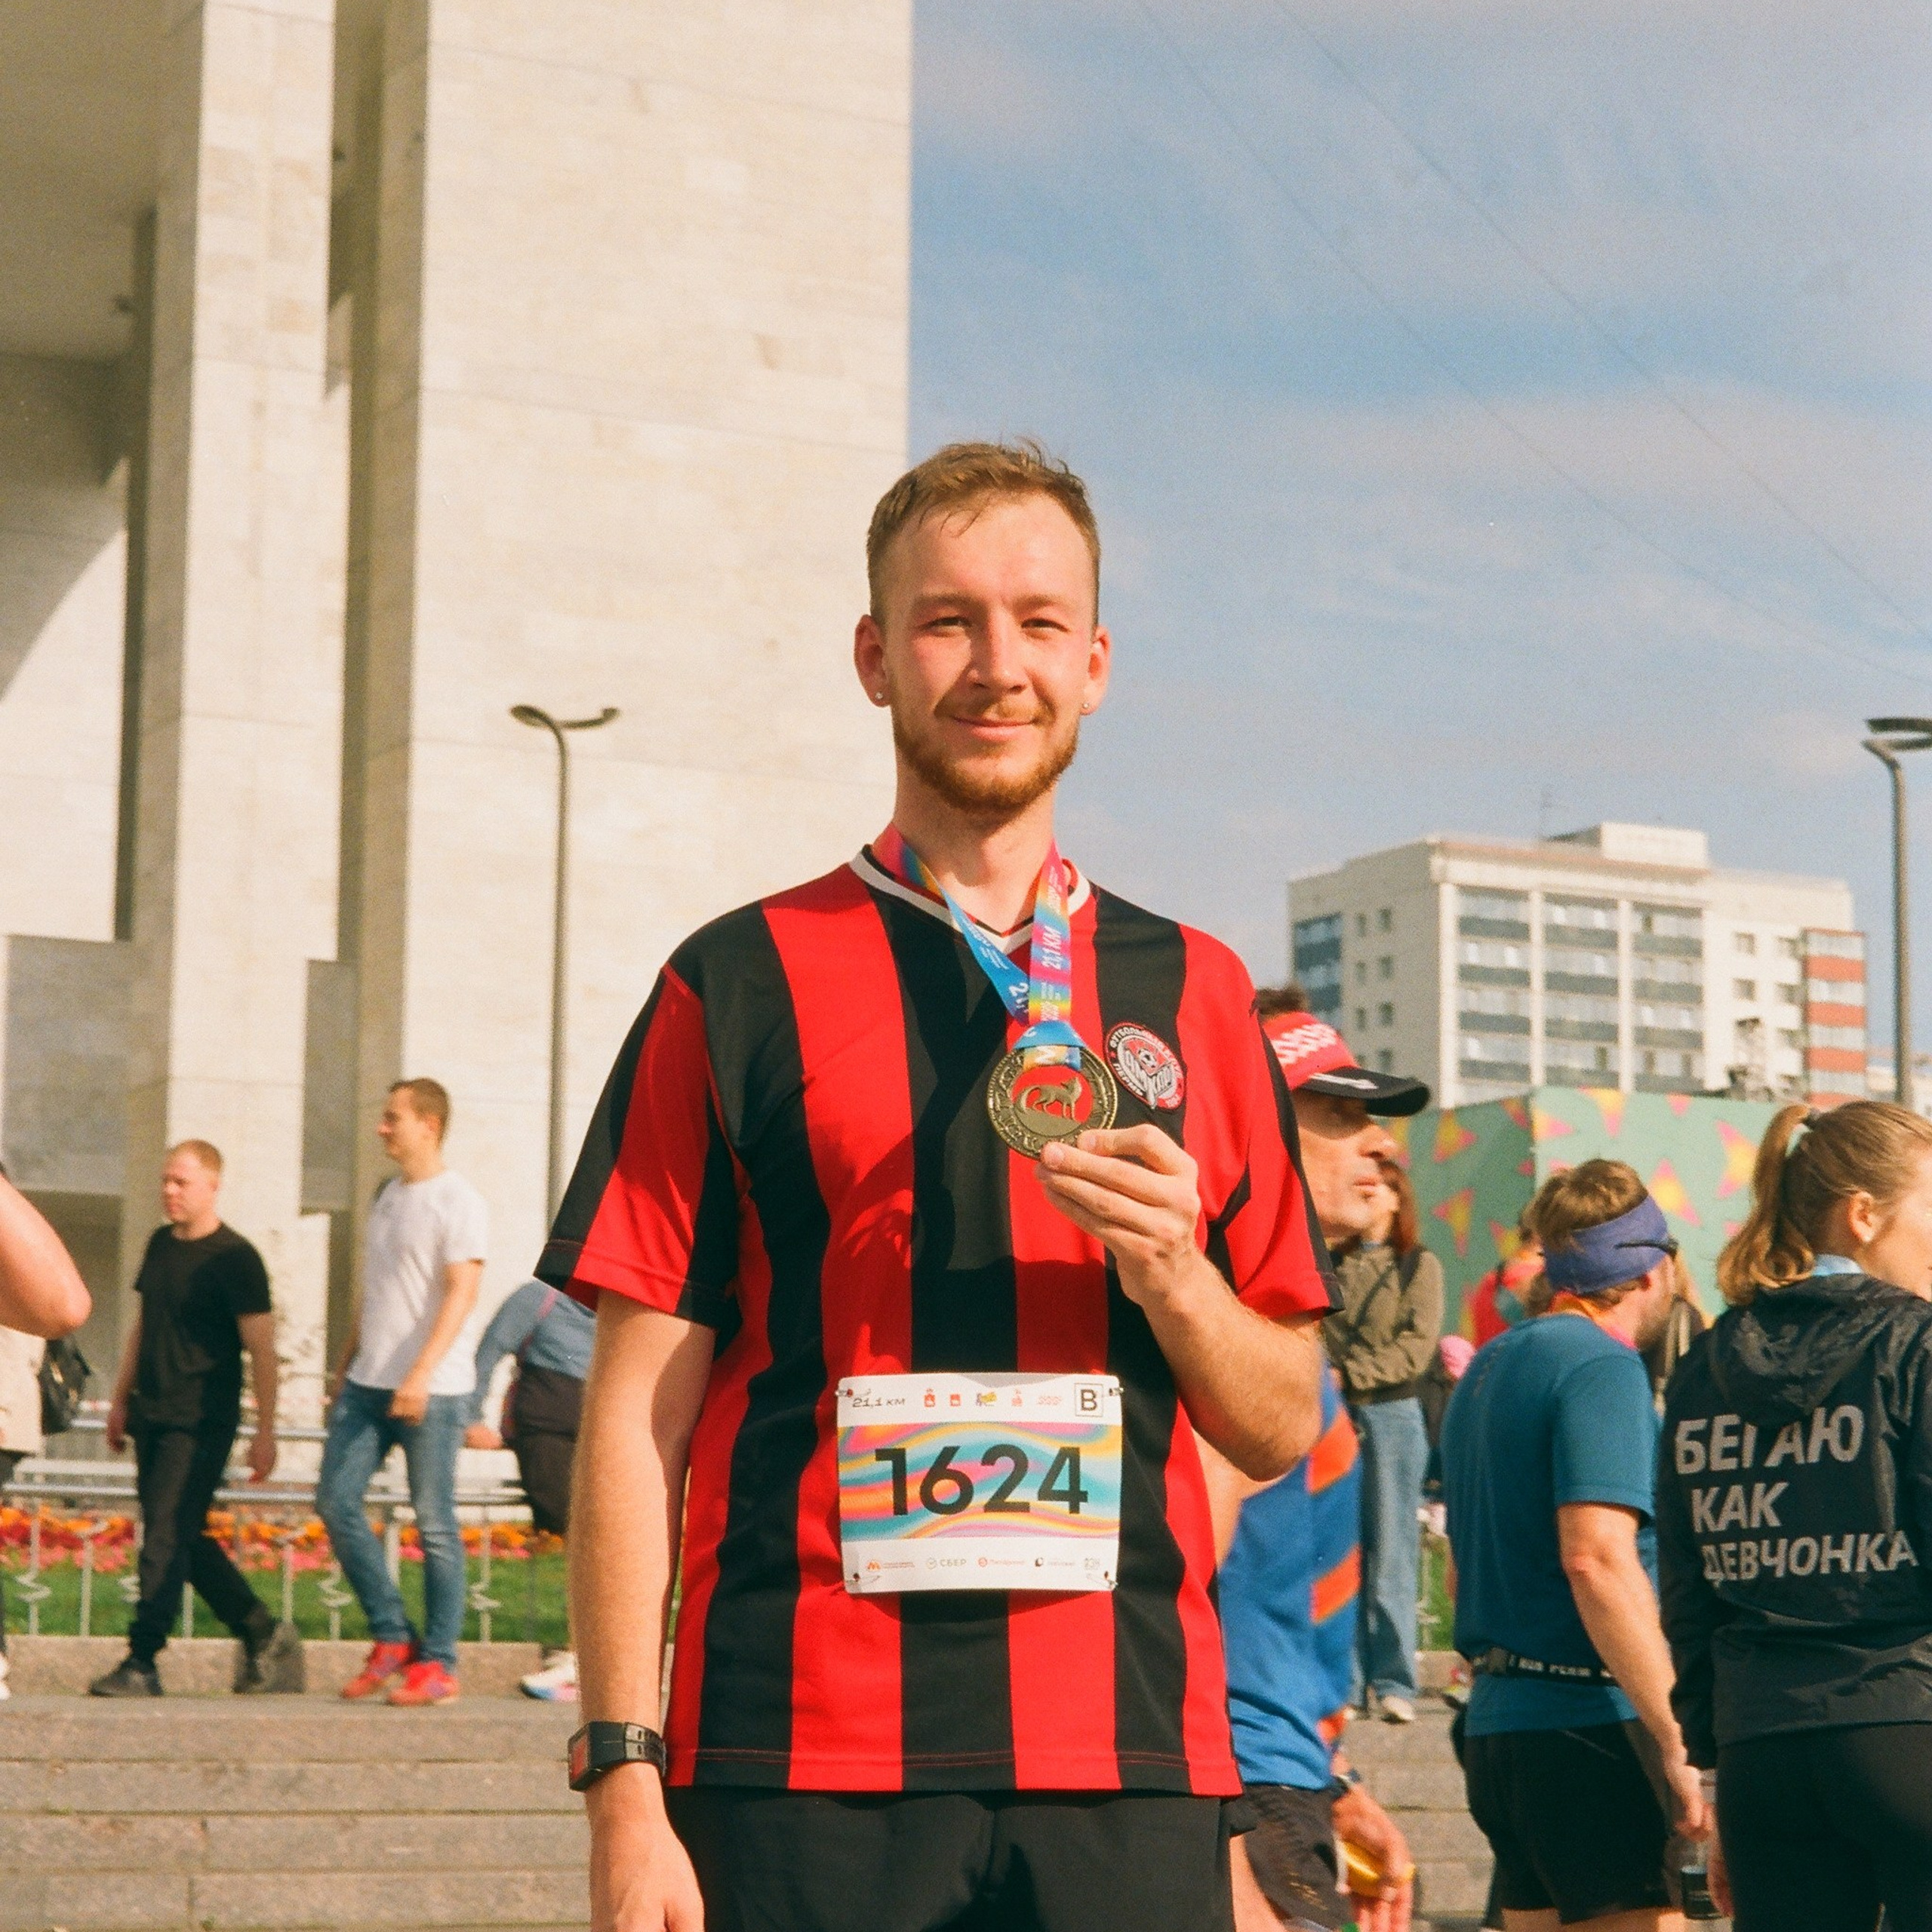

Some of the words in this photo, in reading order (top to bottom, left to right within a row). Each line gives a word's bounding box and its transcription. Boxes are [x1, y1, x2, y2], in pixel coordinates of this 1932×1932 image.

[875, 1444, 1088, 1515] 1624
[1691, 1481, 1789, 1533] КАК
[940, 1558, 967, 1567] СБЕР
[1701, 1531, 1919, 1585] ДЕВЧОНКА
